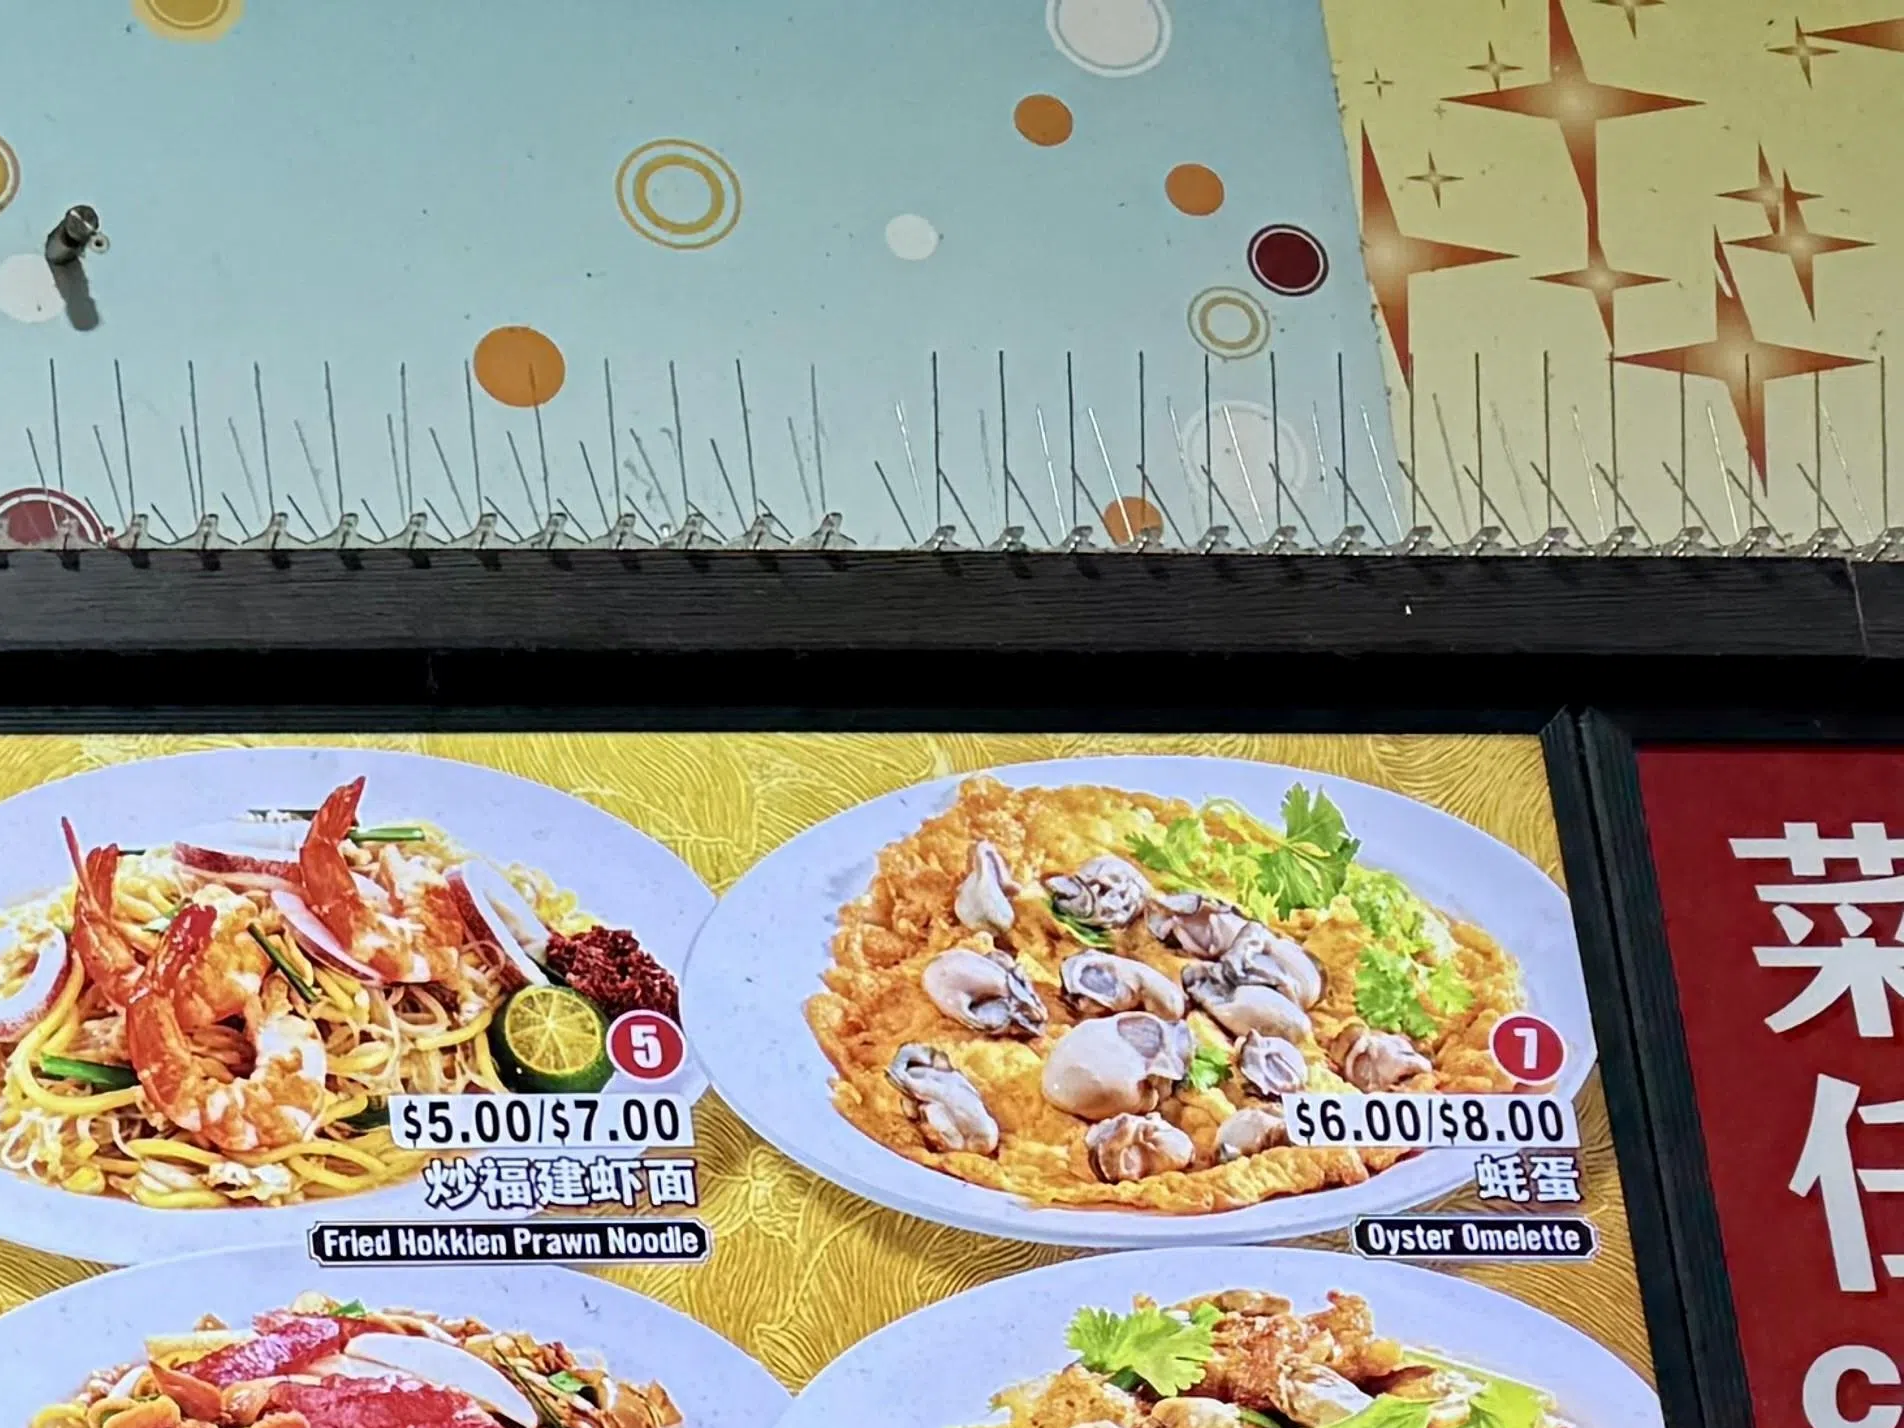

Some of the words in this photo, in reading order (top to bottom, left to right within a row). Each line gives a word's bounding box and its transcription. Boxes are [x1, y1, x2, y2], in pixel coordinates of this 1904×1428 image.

[630, 1024, 664, 1070] 5
[1513, 1027, 1539, 1070] 7
[403, 1099, 679, 1147] $5.00/$7.00
[1296, 1097, 1564, 1145] $6.00/$8.00
[422, 1156, 696, 1209] 炒福建虾面
[1474, 1153, 1581, 1203] 蚝蛋
[323, 1229, 390, 1258] Fried
[399, 1228, 506, 1257] Hokkien
[515, 1228, 600, 1255] Prawn
[607, 1226, 699, 1254] Noodle
[1368, 1223, 1454, 1256] Oyster
[1461, 1223, 1581, 1251] Omelette
